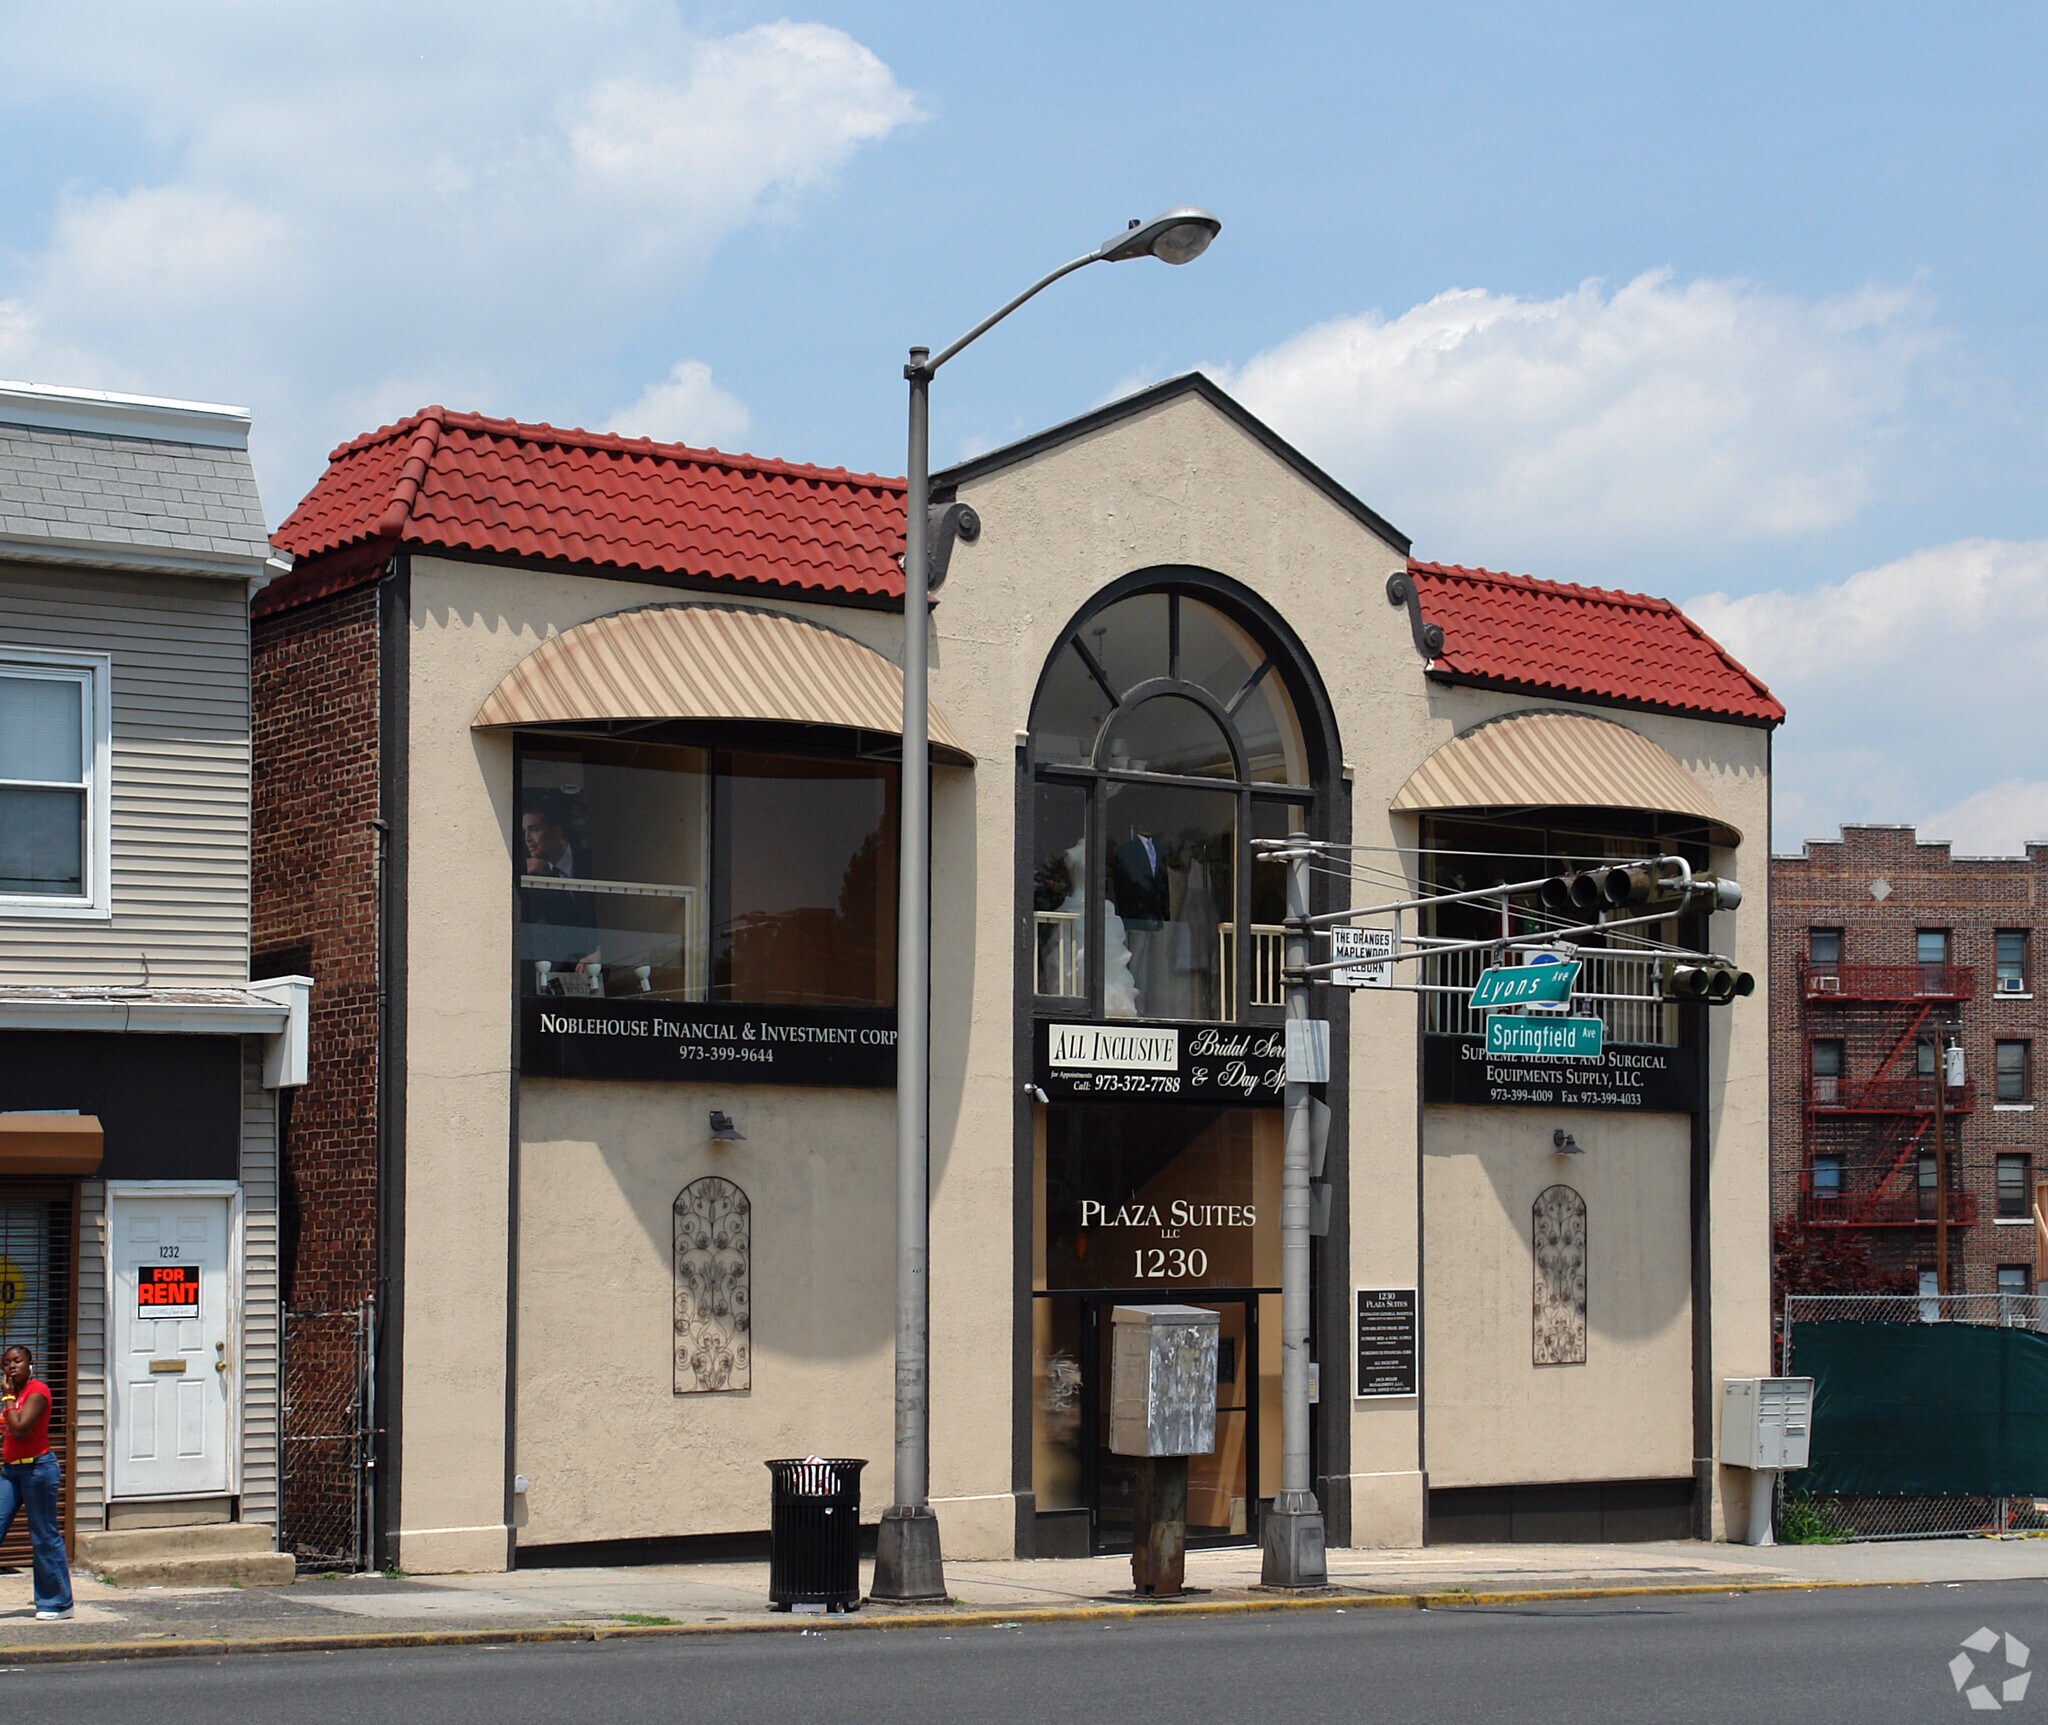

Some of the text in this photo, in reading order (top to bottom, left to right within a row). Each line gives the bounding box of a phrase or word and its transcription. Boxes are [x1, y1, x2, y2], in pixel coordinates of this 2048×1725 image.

[1335, 931, 1390, 946] THE ORANGES
[1336, 946, 1389, 959] MAPLEWOOD
[1480, 970, 1569, 1003] Lyons Ave
[540, 1013, 898, 1045] NOBLEHOUSE FINANCIAL & INVESTMENT CORP
[1493, 1023, 1596, 1053] Springfield Ave
[1053, 1030, 1174, 1063] ALL INCLUSIVE
[1188, 1028, 1249, 1058] Bridal
[679, 1046, 774, 1063] 973-399-9644
[1608, 1051, 1667, 1069] SURGICAL
[1073, 1074, 1181, 1093] Call: 973-372-7788
[1191, 1066, 1209, 1087] &
[1217, 1060, 1260, 1097] Day
[1486, 1065, 1645, 1088] EQUIPMENTS SUPPLY, LLC.
[1490, 1088, 1642, 1106] 973-399-4009 Fax 973-399-4033
[1081, 1200, 1256, 1227] PLAZA SUITES
[1161, 1229, 1181, 1239] LLC
[159, 1246, 179, 1258] 1232
[1134, 1248, 1208, 1278] 1230
[153, 1269, 185, 1282] FOR
[138, 1283, 198, 1304] RENT
